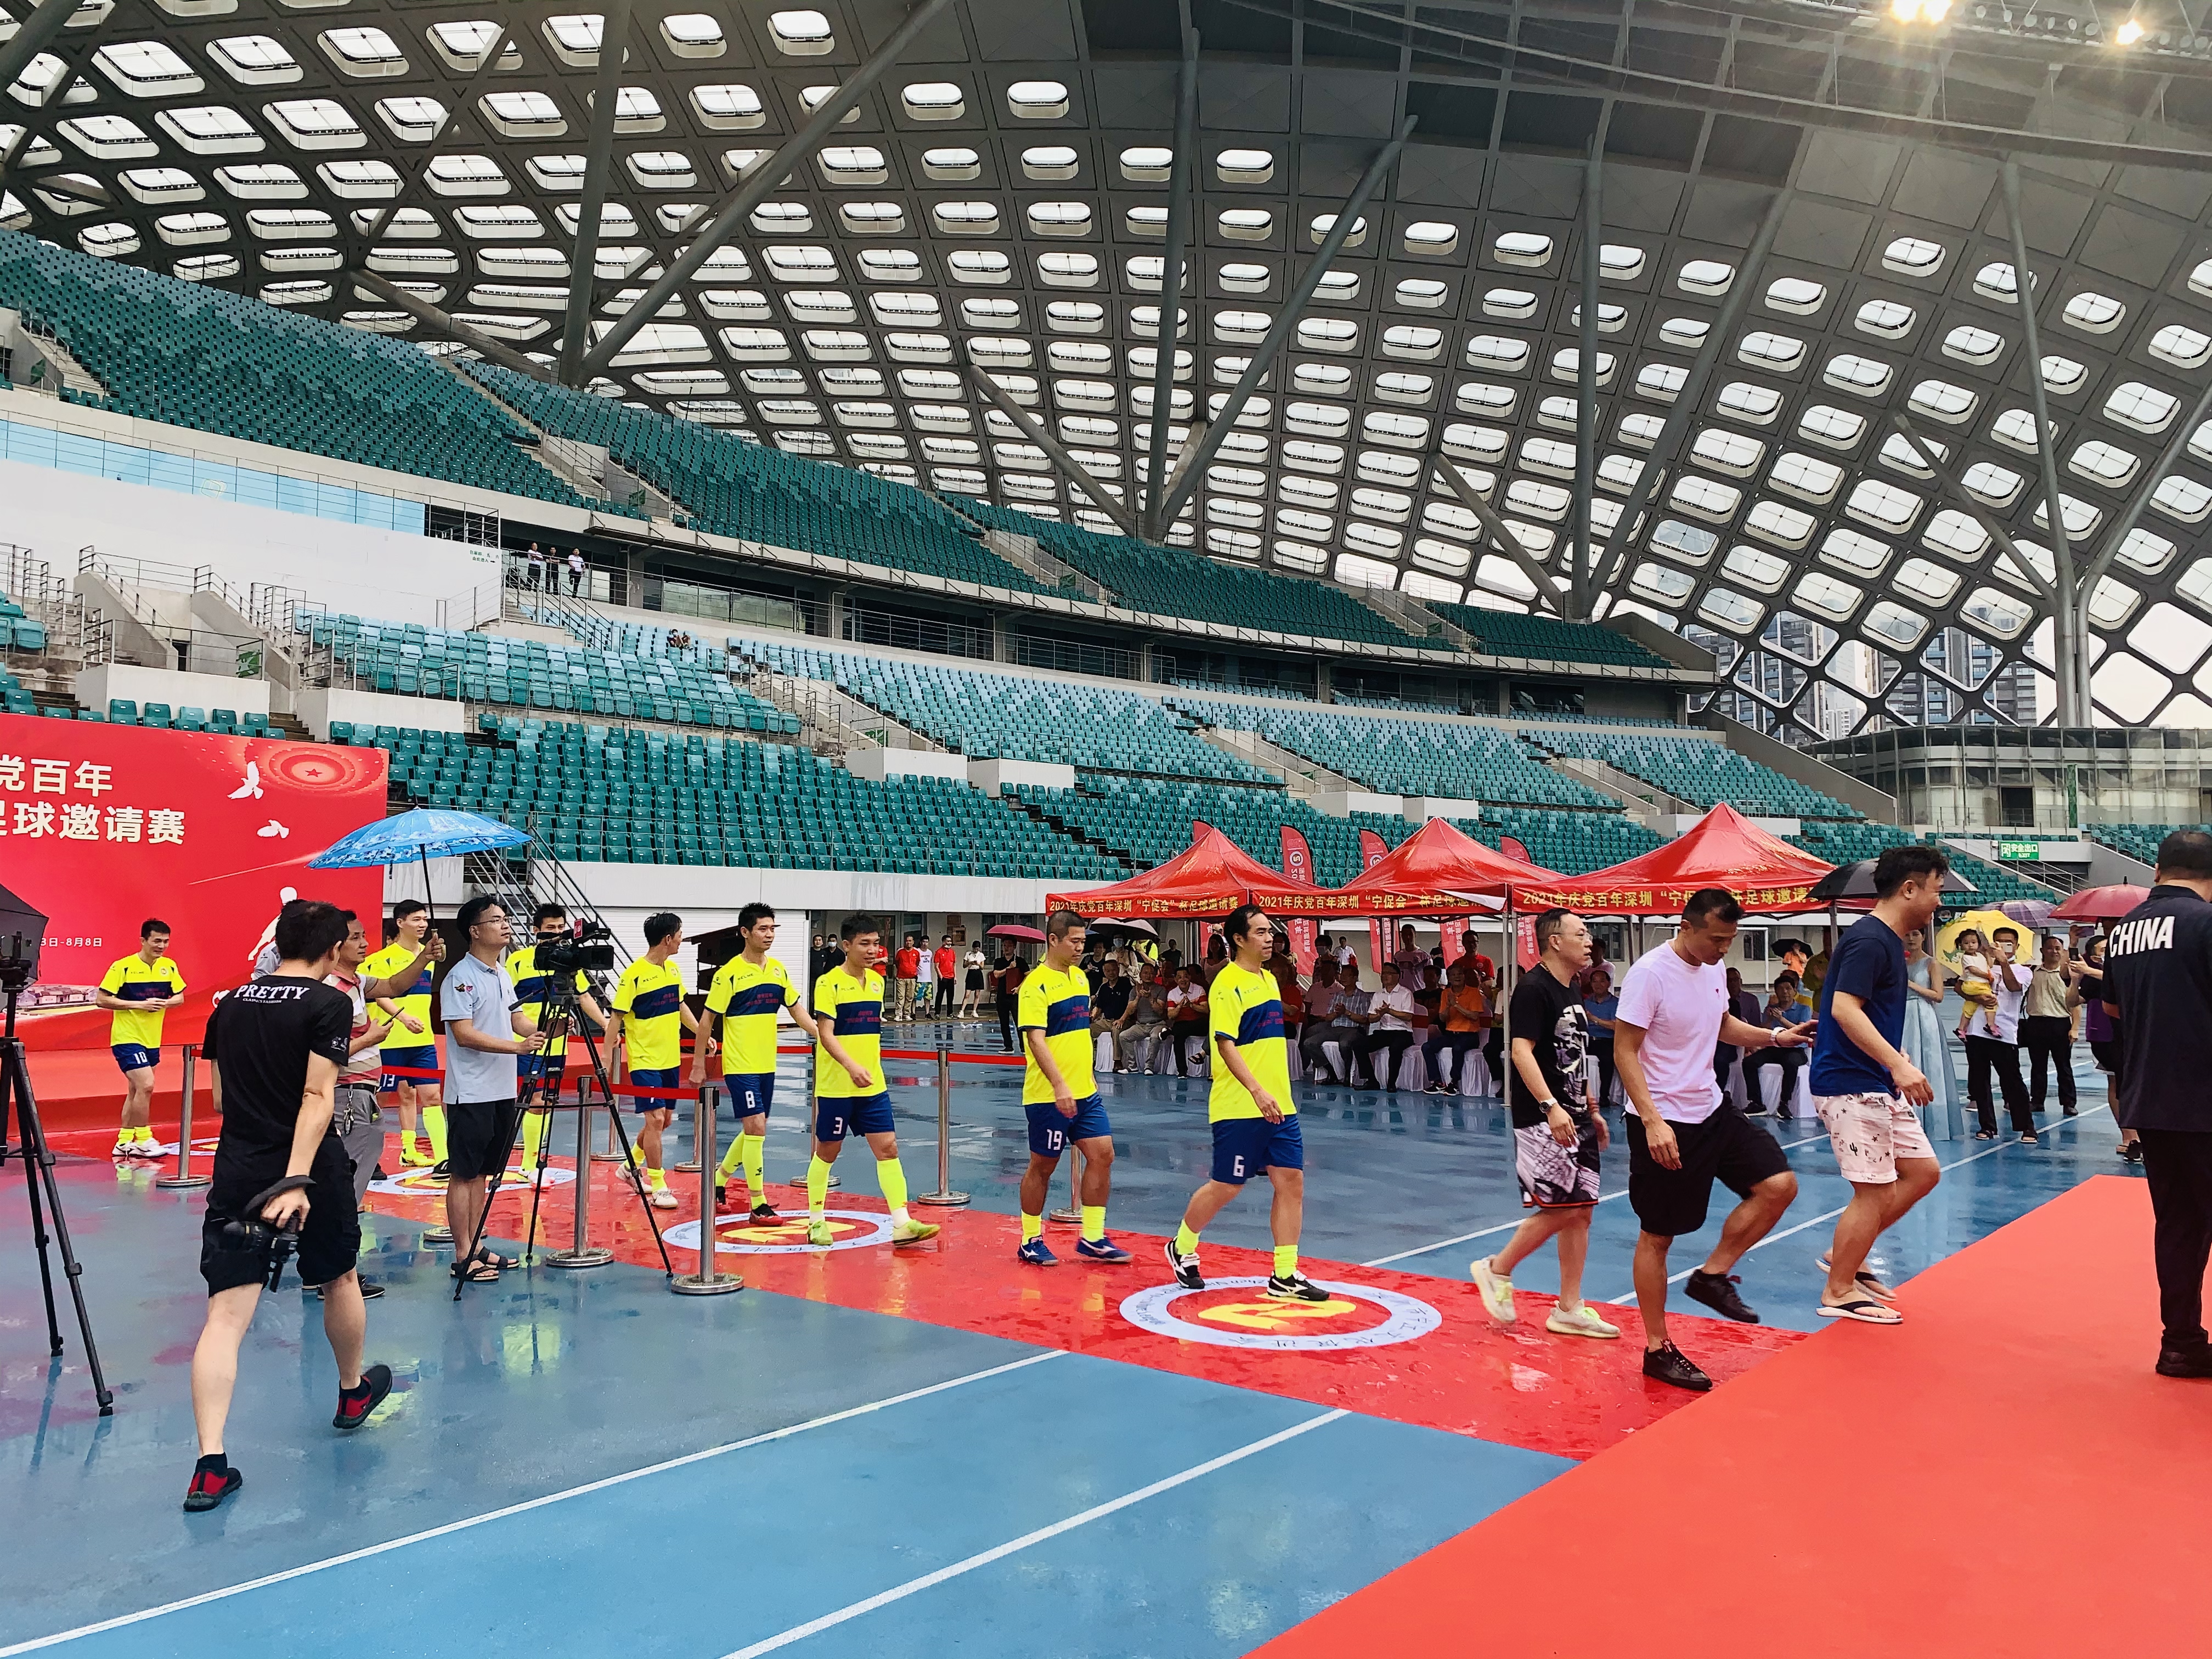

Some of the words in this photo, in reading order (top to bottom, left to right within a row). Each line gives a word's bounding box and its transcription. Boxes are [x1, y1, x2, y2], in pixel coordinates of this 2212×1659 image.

[0, 754, 113, 797] 党百年
[0, 800, 185, 845] 球邀请赛
[2011, 843, 2038, 853] 安全出口
[2109, 916, 2175, 957] CHINA
[234, 984, 310, 1000] PRETTY
[134, 1051, 148, 1064] 10
[745, 1090, 756, 1109] 8
[833, 1116, 843, 1135] 3
[1047, 1128, 1063, 1150] 19
[1233, 1155, 1245, 1177] 6
